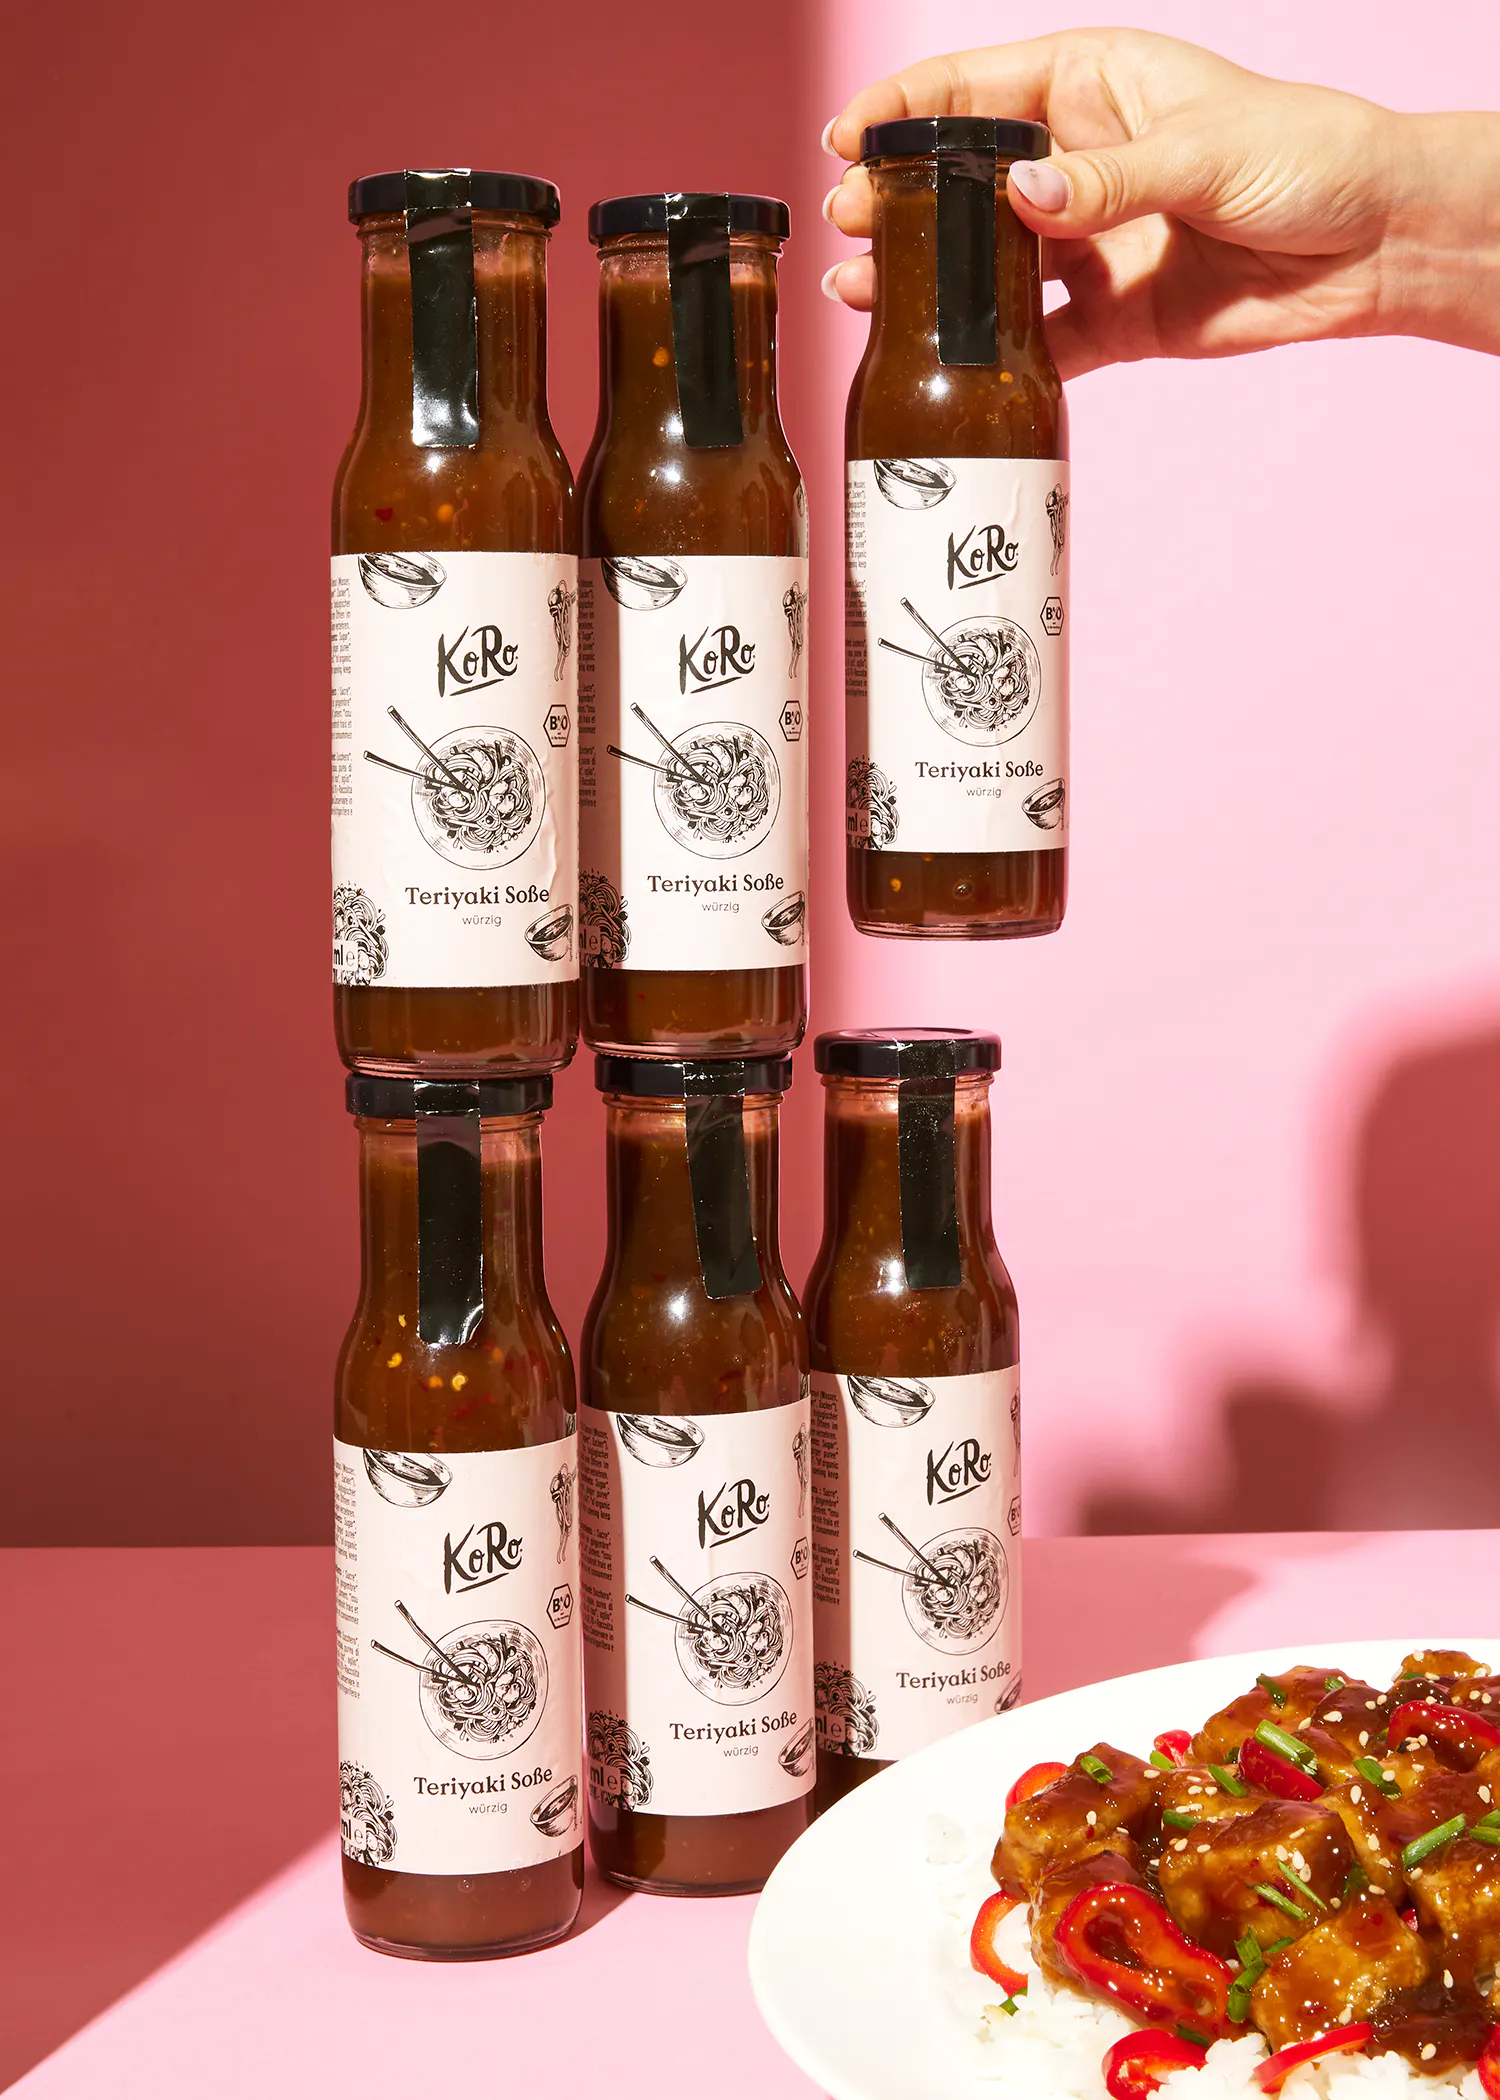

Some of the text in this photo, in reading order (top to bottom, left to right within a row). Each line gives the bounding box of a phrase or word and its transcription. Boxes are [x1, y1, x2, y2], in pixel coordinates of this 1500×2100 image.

[947, 525, 1018, 590] KoRo
[437, 625, 518, 697] KoRo
[679, 626, 755, 694] KoRo
[915, 760, 1044, 783] Teriyaki Soße
[966, 787, 1002, 799] würzig
[405, 885, 550, 907] Teriyaki Soße
[647, 873, 785, 898] Teriyaki Soße
[462, 916, 502, 928] würzig
[701, 903, 740, 914] würzig
[926, 1439, 991, 1505] KoRo
[698, 1479, 769, 1549] KoRo
[443, 1522, 522, 1594] KoRo
[896, 1660, 1012, 1692] Teriyaki Soße
[947, 1693, 979, 1705] würzig
[670, 1711, 797, 1744] Teriyaki Soße
[723, 1744, 760, 1758] würzig
[414, 1766, 553, 1800] Teriyaki Soße
[468, 1803, 508, 1814] würzig
